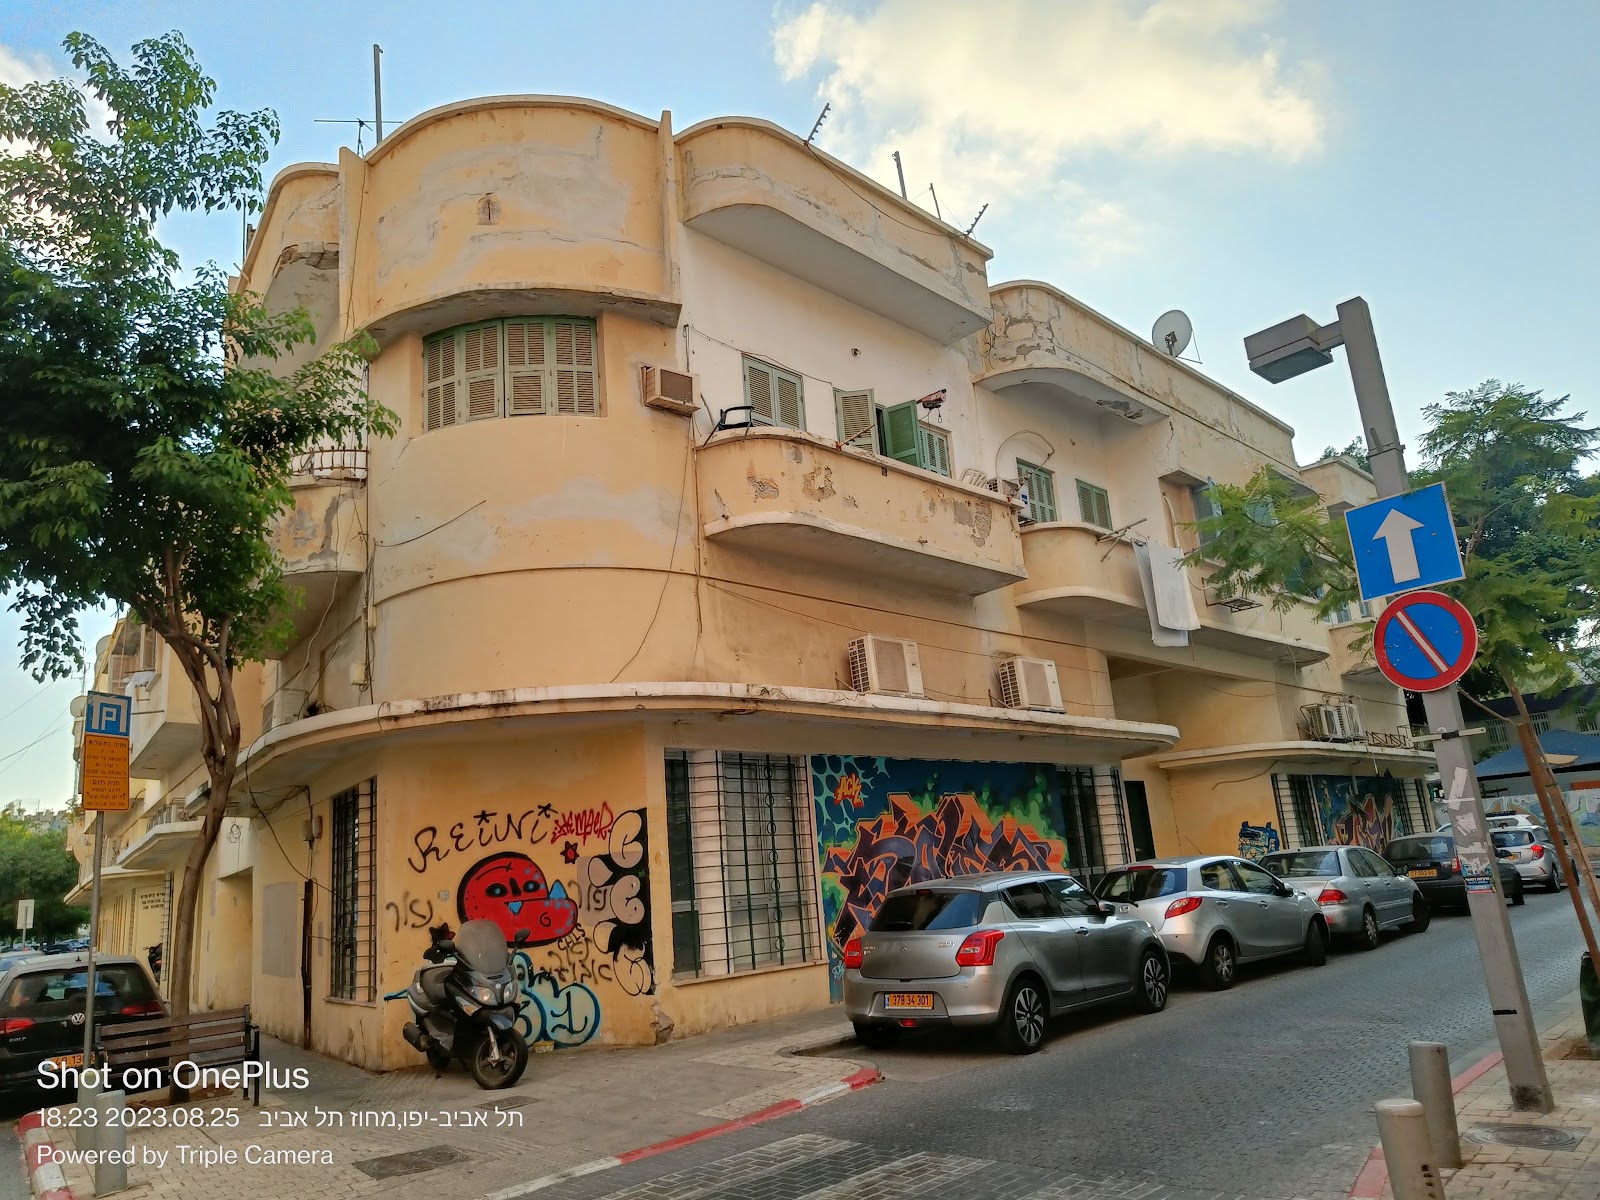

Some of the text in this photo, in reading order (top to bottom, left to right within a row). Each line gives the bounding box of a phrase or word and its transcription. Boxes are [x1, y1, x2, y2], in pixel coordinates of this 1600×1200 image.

[893, 995, 929, 1005] 378 34 301
